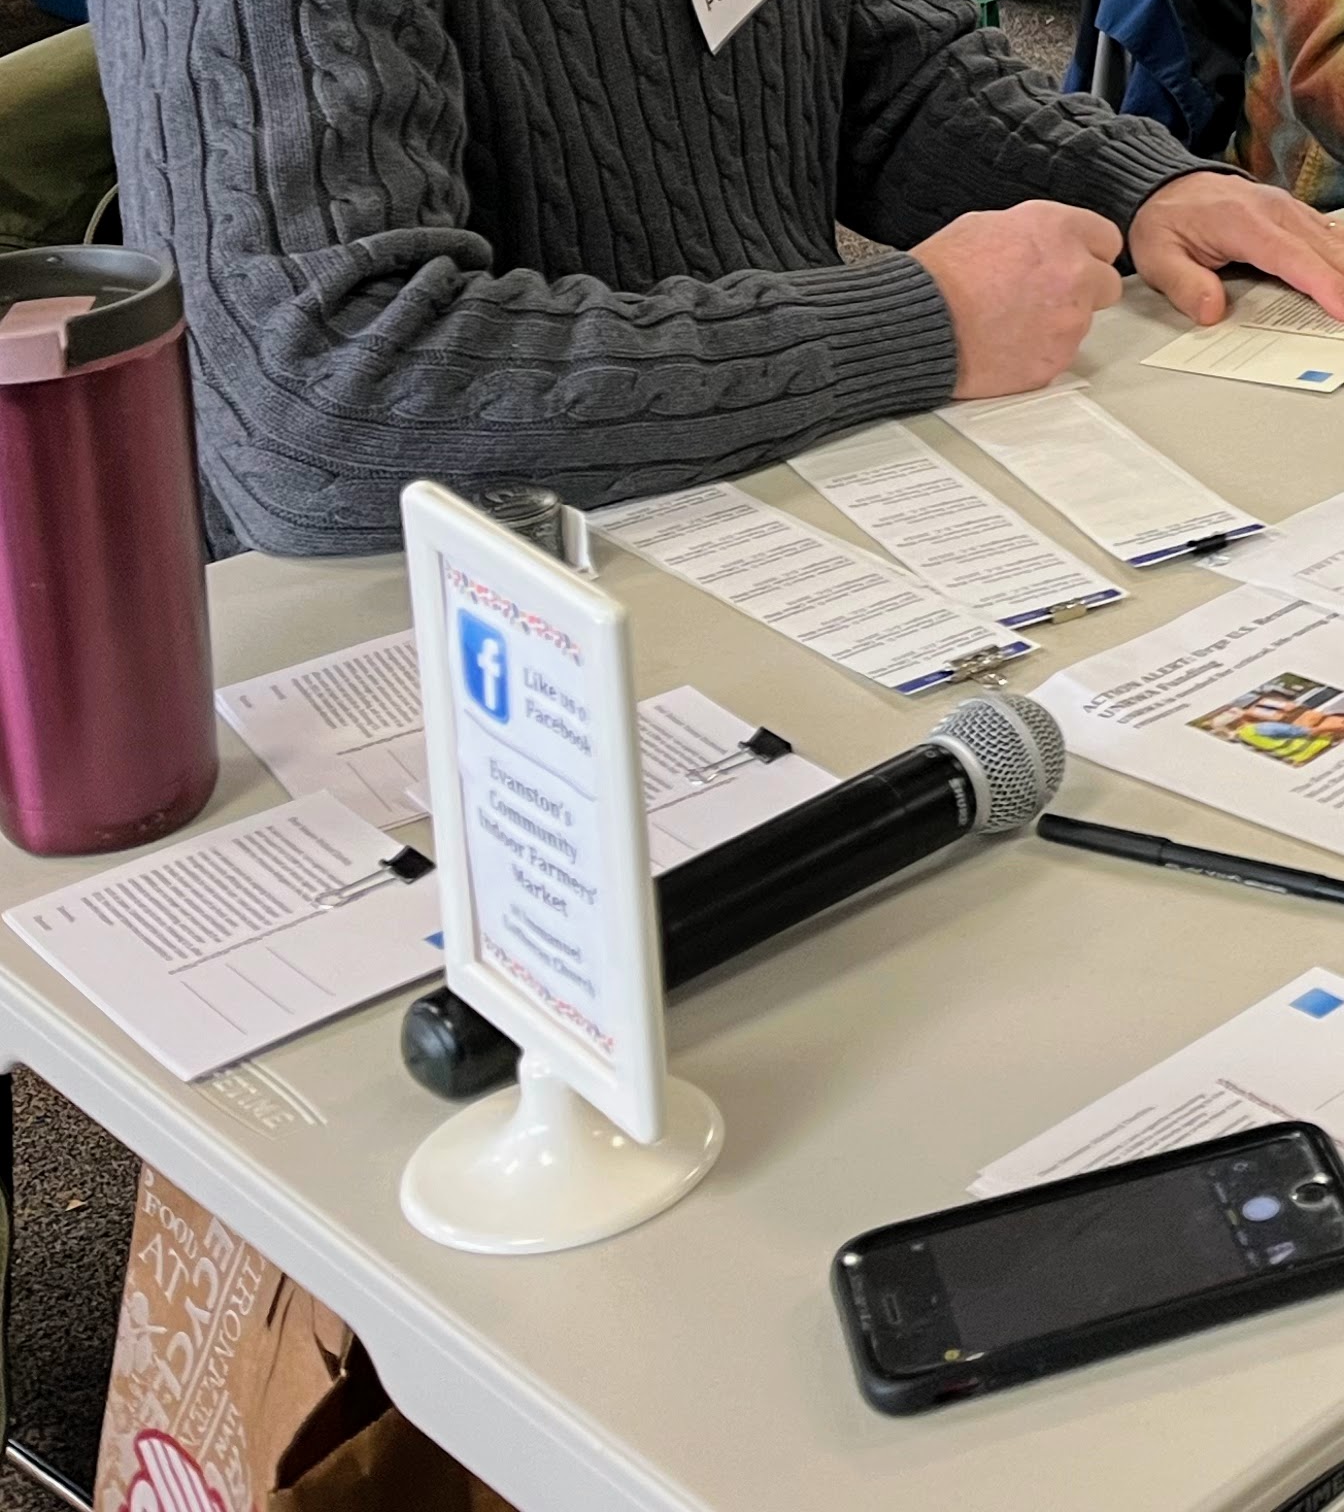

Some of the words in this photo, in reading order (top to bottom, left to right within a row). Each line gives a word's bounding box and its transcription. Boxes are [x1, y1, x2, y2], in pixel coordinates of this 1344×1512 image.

[523, 667, 556, 700] Like
[560, 691, 577, 715] us
[1082, 680, 1142, 714] ACTION
[1140, 655, 1194, 684] ALERT:
[1191, 639, 1232, 658] Urge
[1226, 625, 1257, 640] U.S.
[1098, 687, 1161, 719] UNRWA
[1157, 660, 1225, 692] Funding
[525, 697, 592, 757] Facebook
[489, 759, 573, 827] Evanston's
[478, 806, 525, 857] Indoor
[489, 789, 578, 865] Community
[512, 862, 569, 918] Market
[212, 1074, 295, 1129] ETIME
[142, 1191, 198, 1259] FOOD
[138, 1233, 190, 1304] AT
